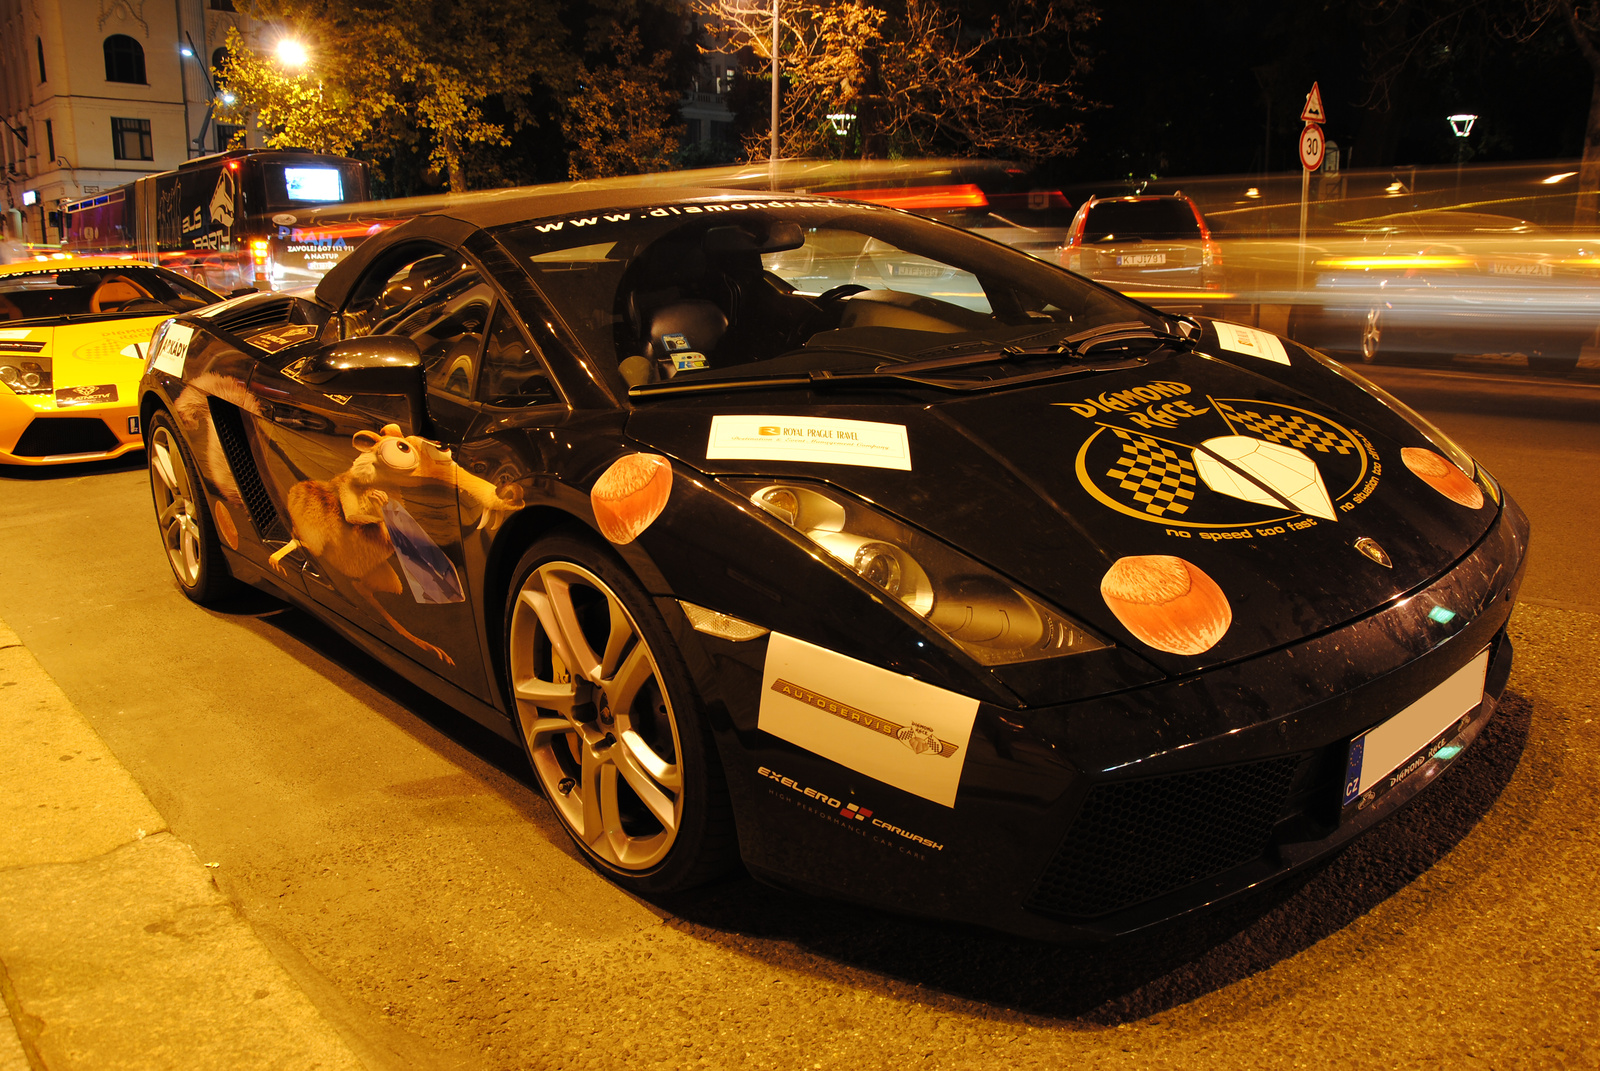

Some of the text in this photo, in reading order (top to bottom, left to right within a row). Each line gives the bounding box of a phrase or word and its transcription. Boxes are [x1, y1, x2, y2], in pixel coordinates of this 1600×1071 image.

[1306, 138, 1318, 156] 30
[182, 205, 202, 234] BUS
[194, 227, 231, 250] PARTY
[278, 226, 346, 247] PRAHA
[102, 328, 153, 337] DIAMON
[1050, 380, 1192, 419] DIAMOND
[1124, 400, 1210, 429] RACE
[783, 427, 803, 437] ROYAL
[808, 429, 833, 439] PRAGUE
[836, 430, 859, 441] TRAVEL
[1339, 501, 1355, 513] no
[1352, 476, 1380, 504] situation
[1371, 461, 1382, 476] too
[1165, 518, 1318, 542] no speed too fast
[782, 685, 892, 735] AUTOSERVIS
[1389, 755, 1425, 788] DIAMOND
[1345, 777, 1359, 797] CZ
[757, 766, 944, 852] EXELERO CARWASH
[768, 789, 926, 862] HIGH PERFORMANCE CAR CARE
